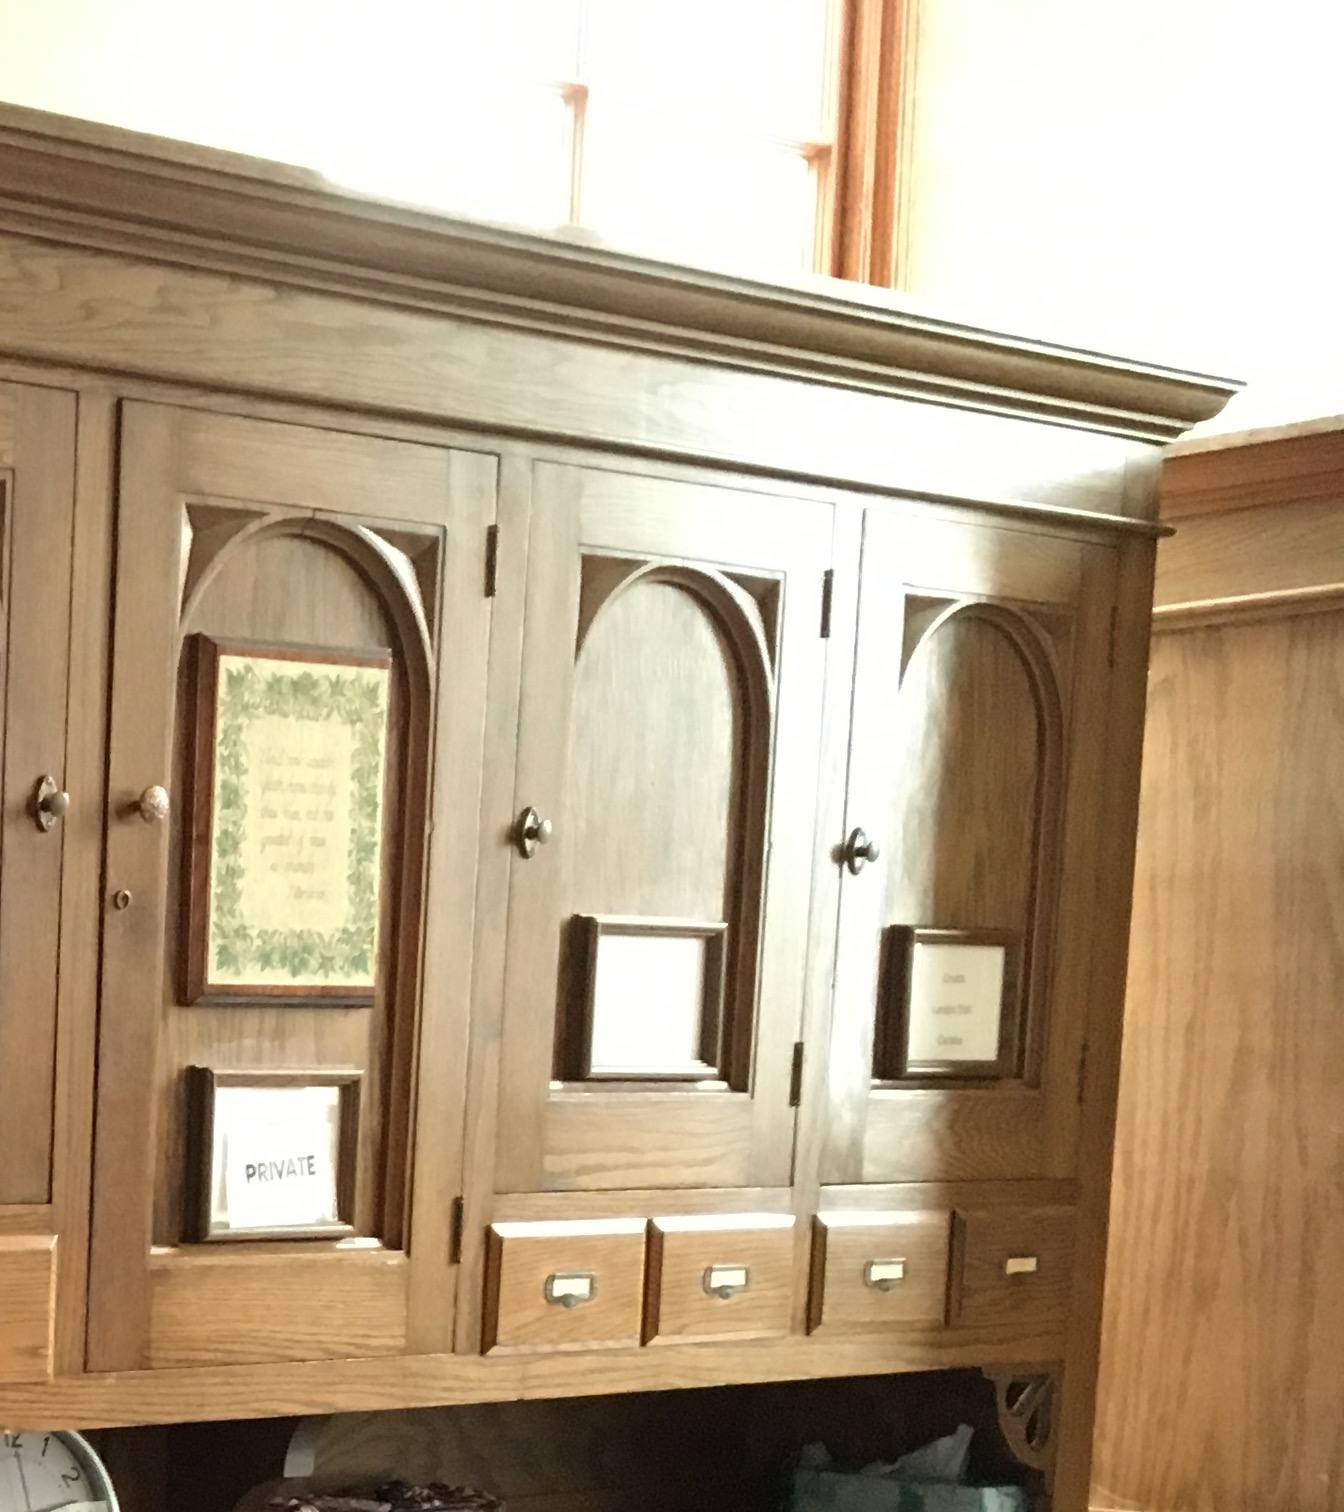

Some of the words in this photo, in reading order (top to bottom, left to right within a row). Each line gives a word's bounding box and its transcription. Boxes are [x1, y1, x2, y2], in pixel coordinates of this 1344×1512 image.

[244, 1154, 317, 1184] PRIVATE
[41, 1436, 51, 1457] 1
[61, 1466, 81, 1488] 2
